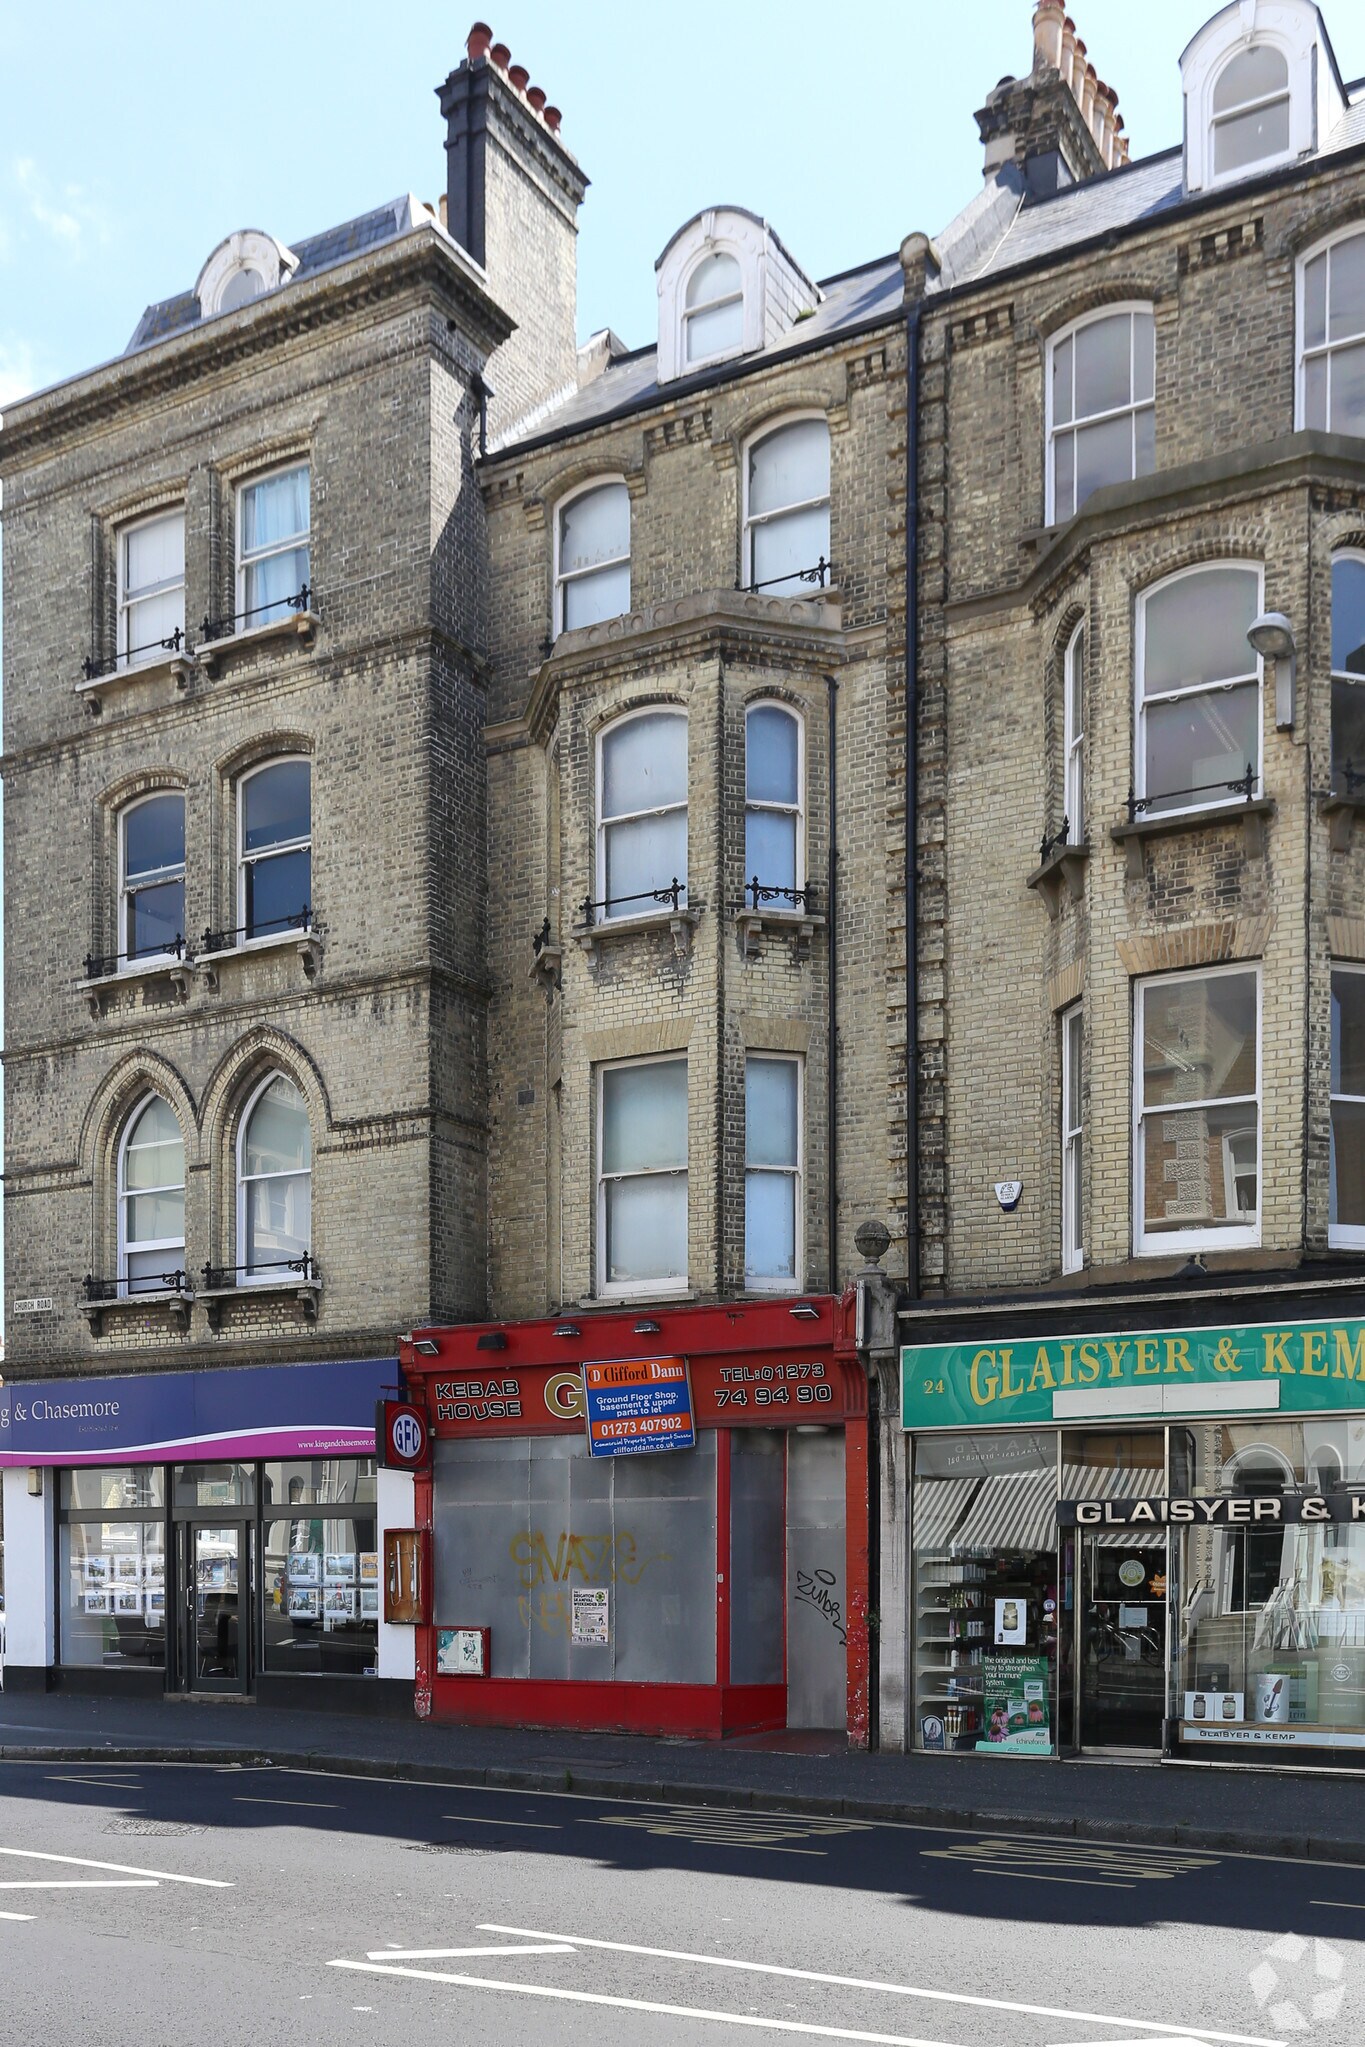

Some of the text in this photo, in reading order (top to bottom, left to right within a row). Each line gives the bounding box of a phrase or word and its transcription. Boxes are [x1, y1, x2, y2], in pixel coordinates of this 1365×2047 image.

[15, 1299, 51, 1311] CHURCH ROAD
[604, 1364, 648, 1382] Clifford
[651, 1363, 683, 1379] Dann
[969, 1337, 1195, 1406] GLAISYER
[1213, 1336, 1243, 1373] &
[435, 1379, 520, 1400] KEBAB
[923, 1379, 945, 1394] 24
[596, 1394, 628, 1405] Ground
[630, 1393, 653, 1402] Floor
[714, 1384, 832, 1407] 74 94 90
[14, 1402, 27, 1421] &
[31, 1400, 120, 1420] Chasemore
[437, 1400, 521, 1421] HOUSE
[600, 1398, 677, 1411] basement & upper
[616, 1408, 639, 1418] parts
[601, 1417, 682, 1436] 01273 407902
[395, 1419, 420, 1453] GFC
[624, 1437, 646, 1446] Property
[613, 1441, 675, 1454] clifforddann.co.uk
[1075, 1498, 1282, 1524] GLAISYER
[1301, 1497, 1332, 1520] &
[984, 1656, 995, 1664] The
[995, 1656, 1015, 1665] original
[1005, 1665, 1036, 1673] strengthen
